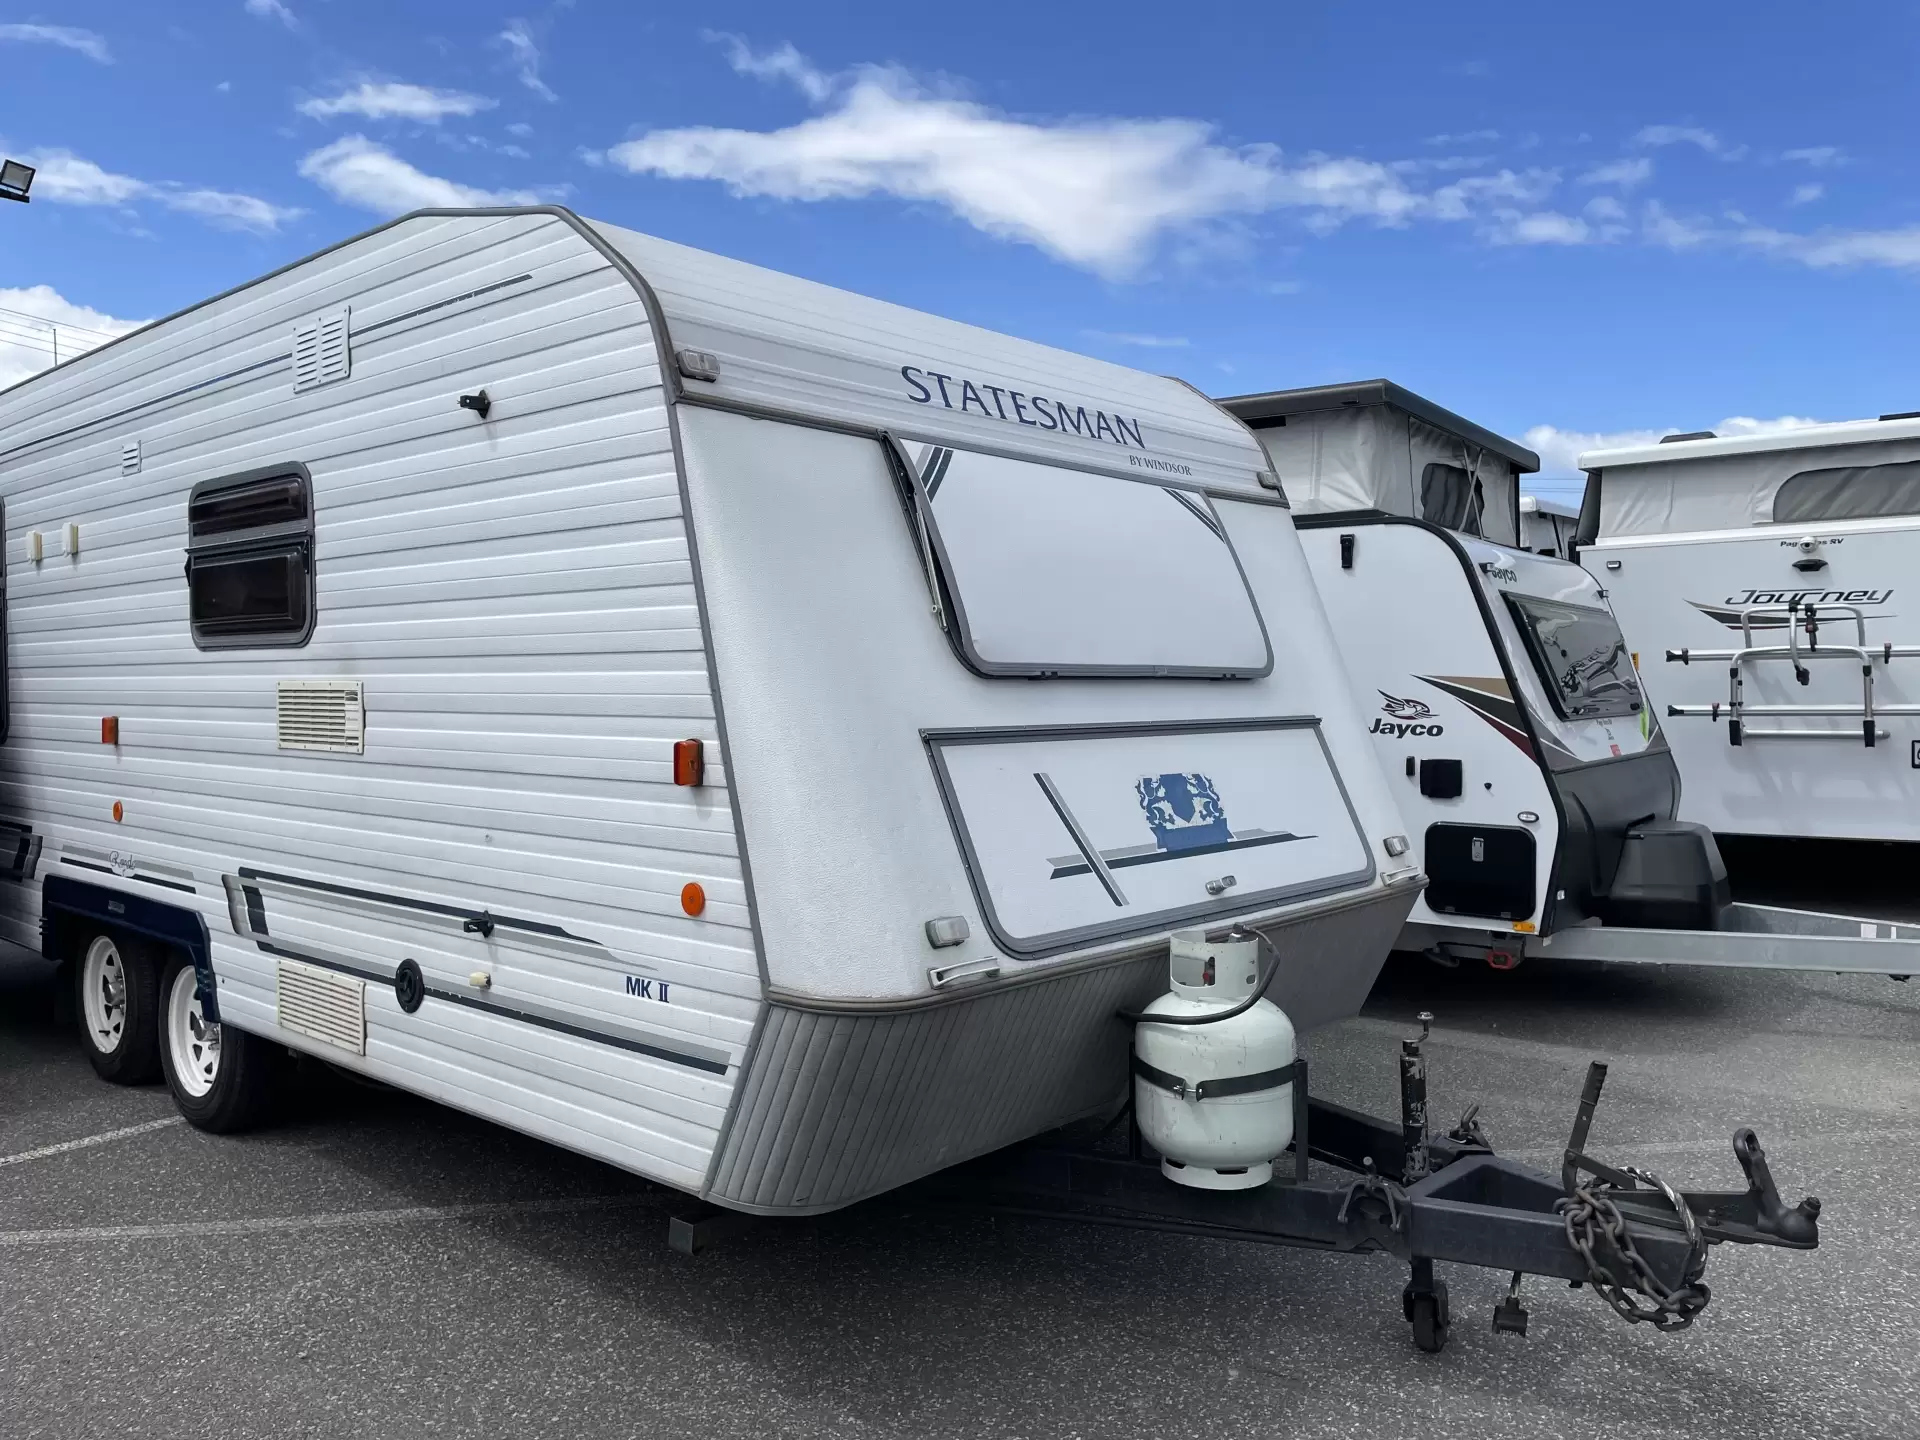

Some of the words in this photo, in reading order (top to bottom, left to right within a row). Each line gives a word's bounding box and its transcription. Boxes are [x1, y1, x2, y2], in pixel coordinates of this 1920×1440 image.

[901, 365, 1146, 449] STATESMAN
[1129, 454, 1142, 467] BY
[1143, 457, 1193, 476] WINDSOR
[1725, 588, 1895, 605] Journey
[1368, 717, 1444, 740] Jayco
[626, 975, 652, 1000] MK
